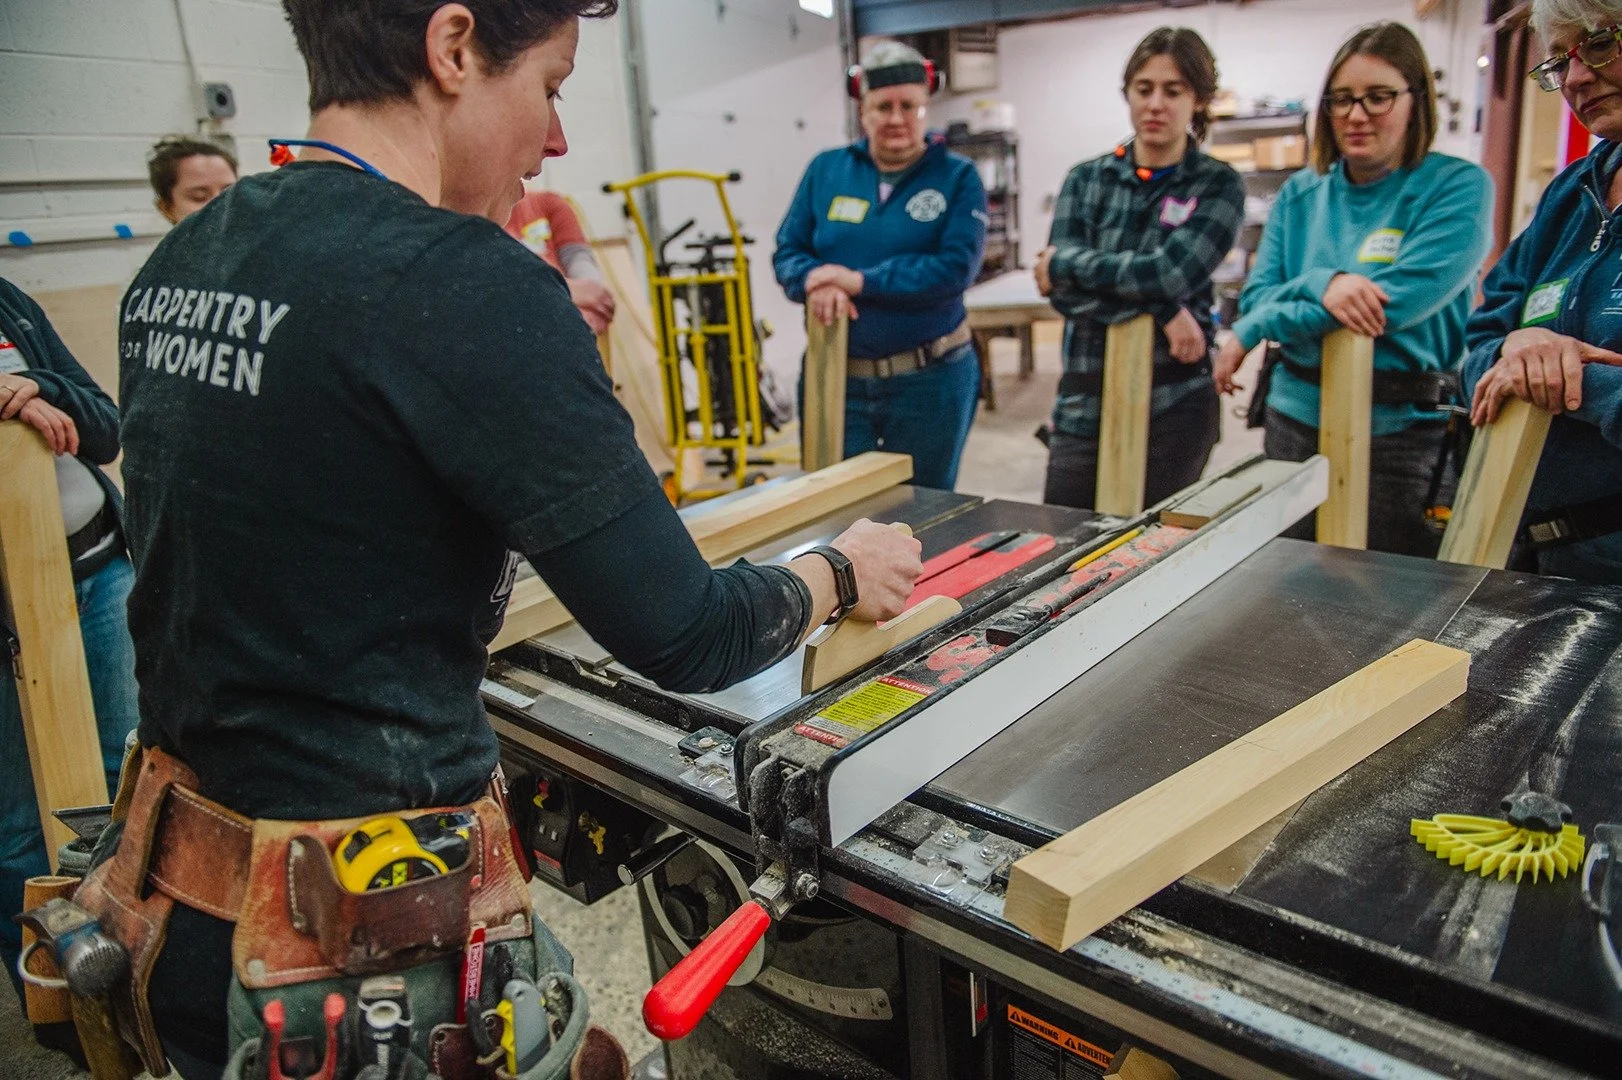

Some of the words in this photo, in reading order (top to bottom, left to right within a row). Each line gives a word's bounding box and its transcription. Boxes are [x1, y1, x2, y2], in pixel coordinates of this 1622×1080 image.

[124, 287, 291, 344] CARPENTRY
[146, 329, 265, 396] WOMEN
[881, 677, 933, 695] ATTENTION
[1021, 1015, 1060, 1041] WARNING
